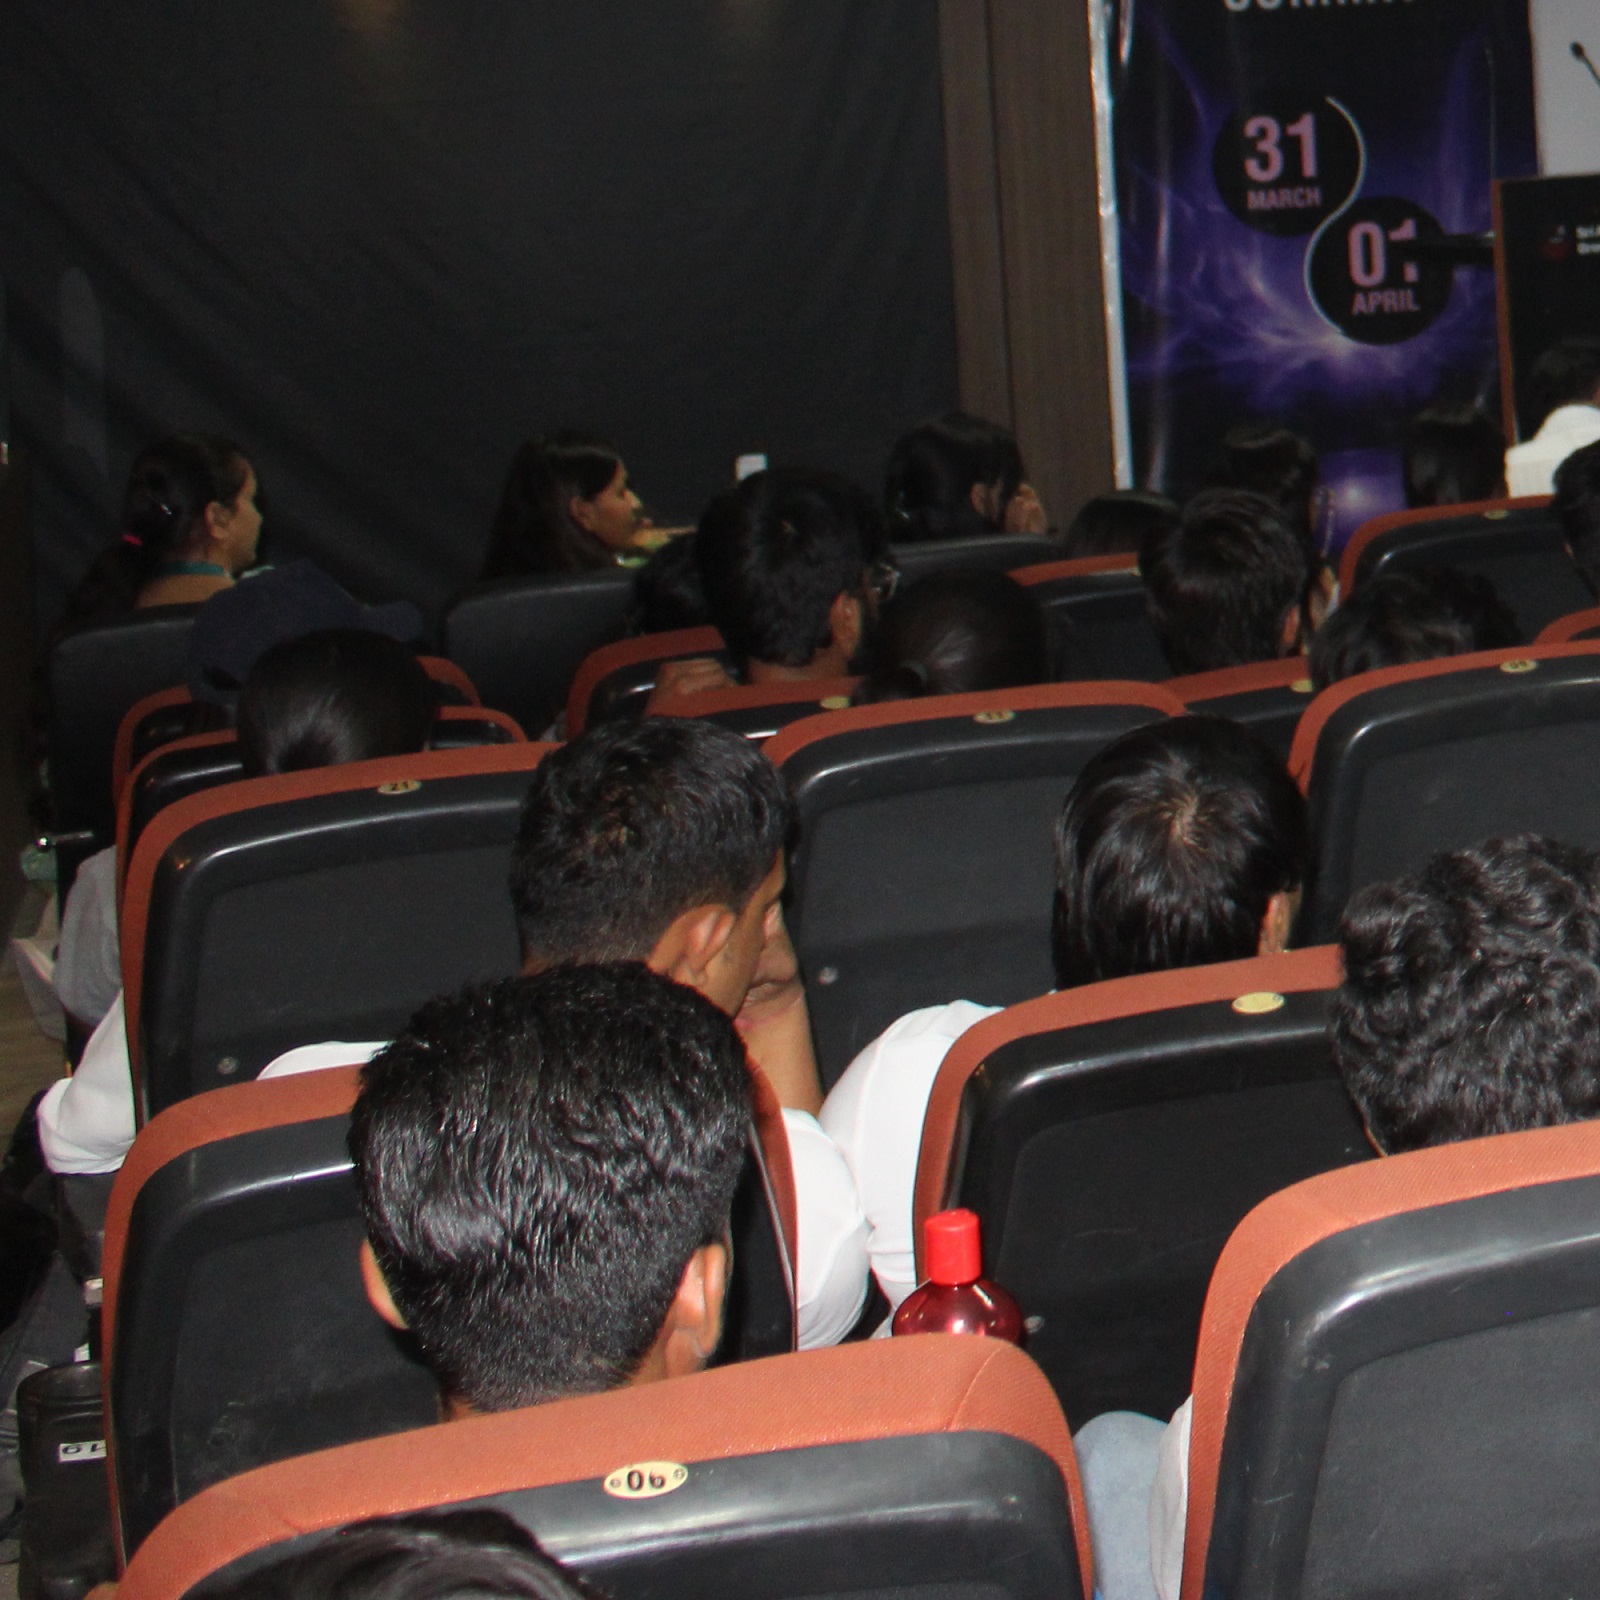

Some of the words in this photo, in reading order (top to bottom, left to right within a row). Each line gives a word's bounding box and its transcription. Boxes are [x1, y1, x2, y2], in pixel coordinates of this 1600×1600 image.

[1243, 113, 1318, 183] 31
[1246, 186, 1322, 211] MARCH
[1351, 288, 1420, 316] APRIL
[627, 1469, 666, 1491] 06
